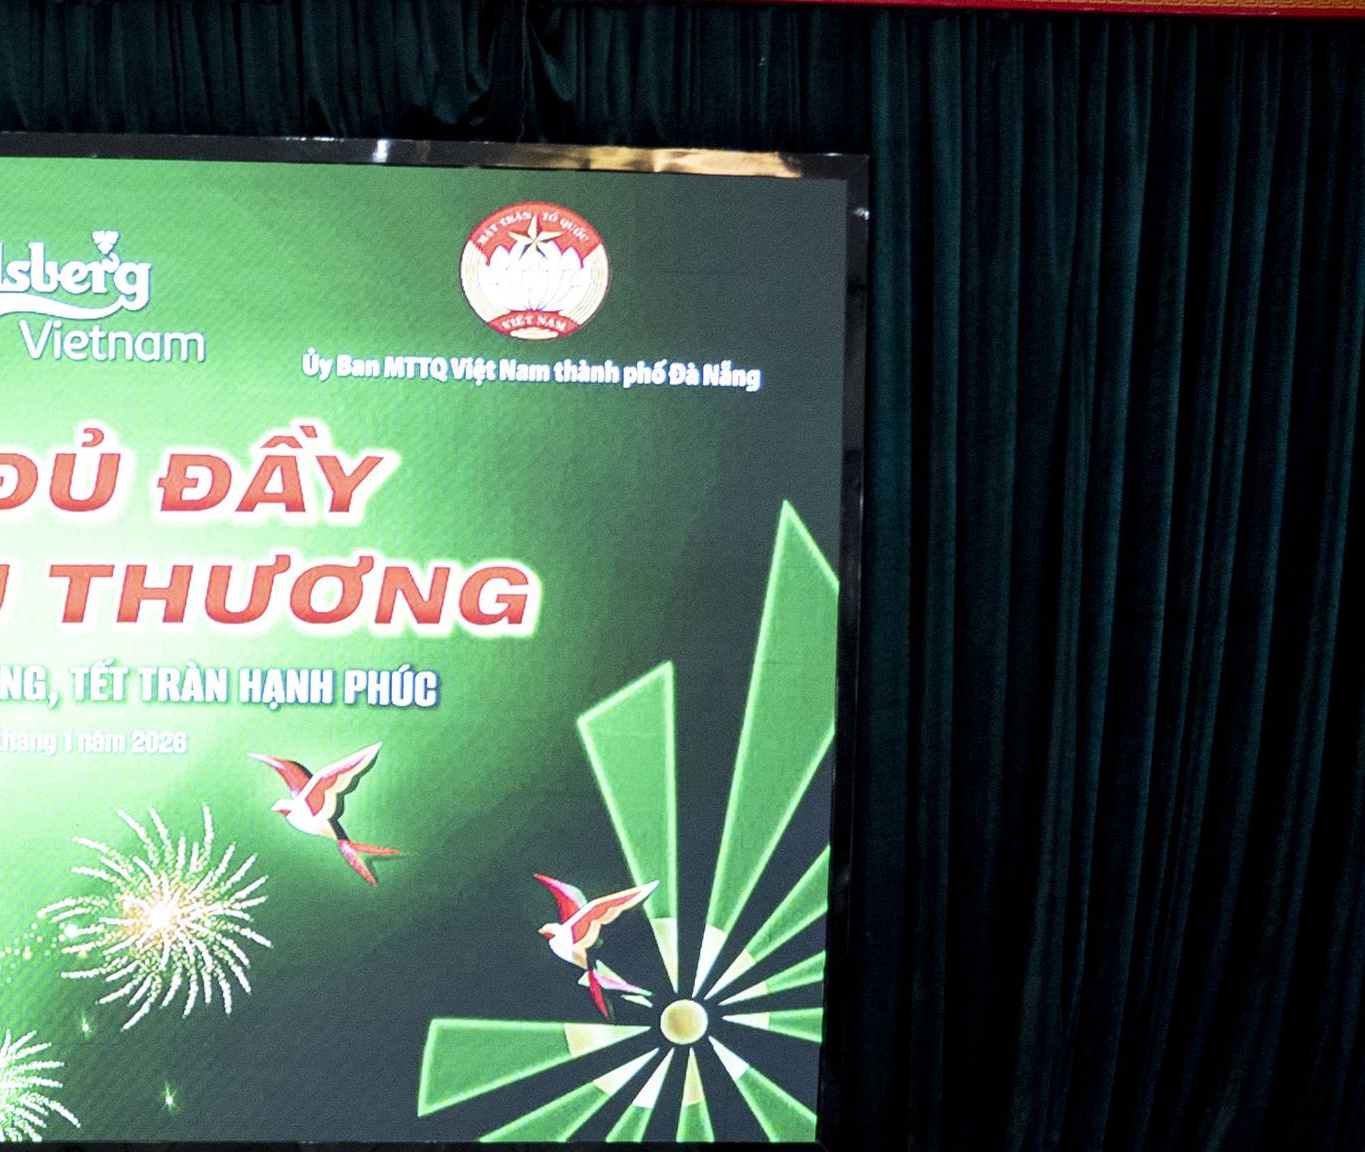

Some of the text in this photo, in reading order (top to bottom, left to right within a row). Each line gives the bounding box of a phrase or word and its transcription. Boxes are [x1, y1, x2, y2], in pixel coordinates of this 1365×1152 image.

[19, 319, 206, 362] Vietnam
[536, 315, 567, 331] NAM
[302, 347, 333, 381] Ủy
[336, 354, 380, 377] Ban
[384, 355, 448, 382] MTTQ
[450, 356, 496, 386] Việt
[499, 358, 551, 382] Nam
[553, 359, 619, 384] thành
[622, 359, 668, 388] phố
[669, 361, 699, 385] Đà
[157, 425, 382, 513] ĐẦY
[49, 553, 529, 626] THƯƠNG
[70, 659, 129, 702] TẾT
[138, 661, 229, 702] TRÀN
[239, 668, 333, 710] HẠNH
[344, 664, 440, 707] PHÚC
[131, 731, 188, 753] 2026
